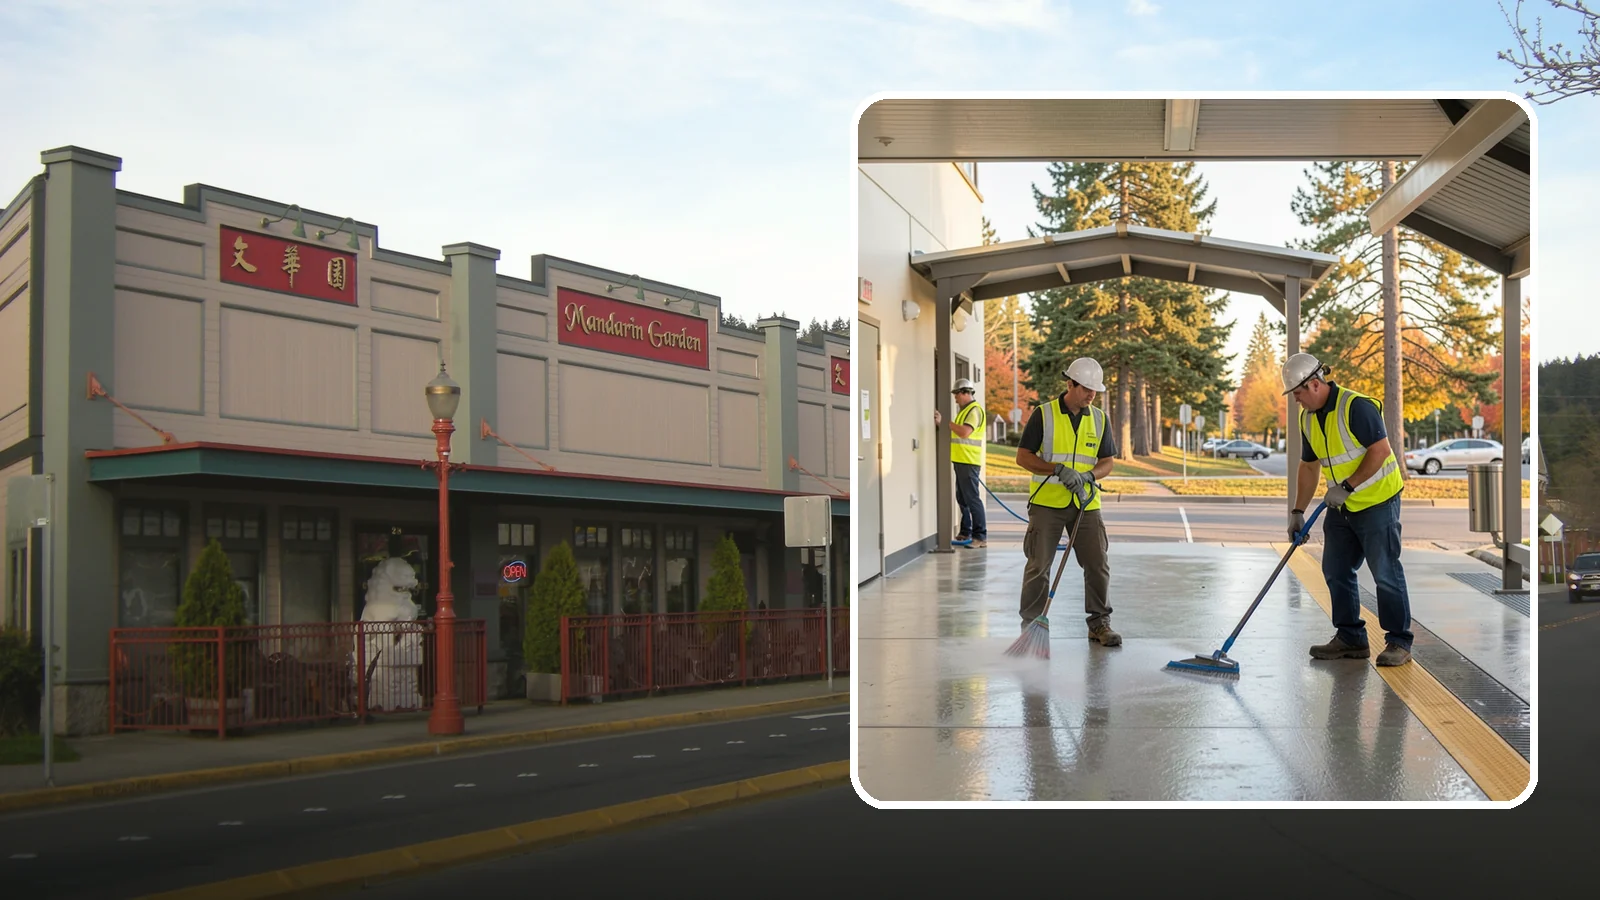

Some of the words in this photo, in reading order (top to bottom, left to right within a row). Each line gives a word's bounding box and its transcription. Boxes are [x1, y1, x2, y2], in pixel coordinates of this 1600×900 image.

[564, 302, 644, 341] Mandarin
[647, 320, 702, 352] Garden
[503, 565, 527, 579] OPEN
